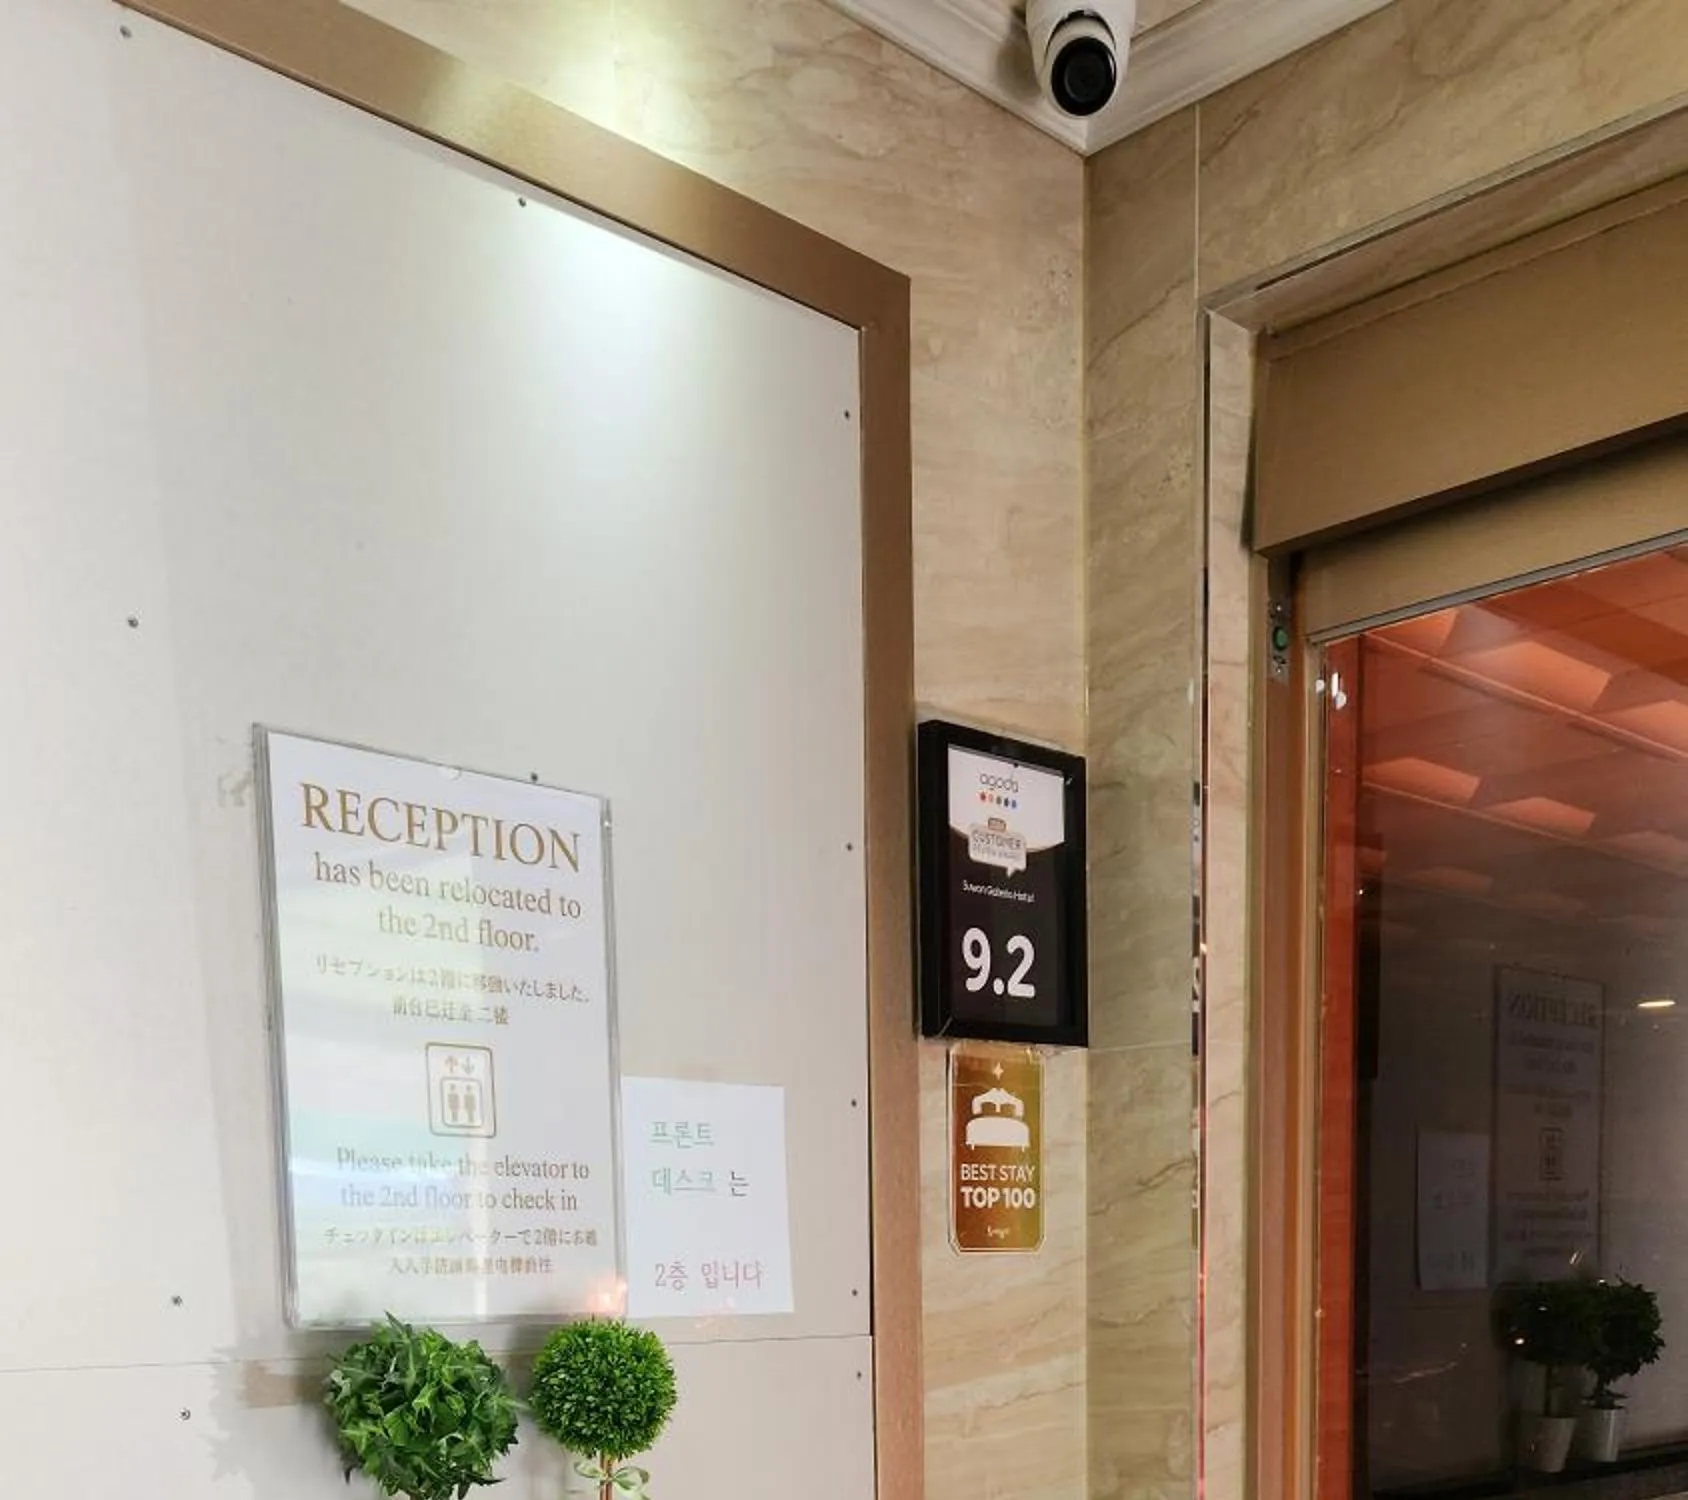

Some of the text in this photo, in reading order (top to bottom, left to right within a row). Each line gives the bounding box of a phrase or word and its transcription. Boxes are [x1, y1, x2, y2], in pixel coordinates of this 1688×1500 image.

[979, 772, 1019, 794] agoda
[300, 782, 581, 873] RECEPTION
[972, 830, 1022, 850] CUSTOMER
[315, 852, 581, 919] has been relocated to
[378, 905, 540, 952] the 2nd floor.
[962, 927, 1036, 998] 9.2
[650, 1120, 715, 1149] 프론트
[336, 1146, 590, 1180] Please take the elevator to
[960, 1163, 1036, 1182] BEST STAY
[340, 1182, 578, 1212] the 2nd floor to check in
[729, 1170, 750, 1197] 는
[654, 1259, 763, 1291] 2층 입니다
